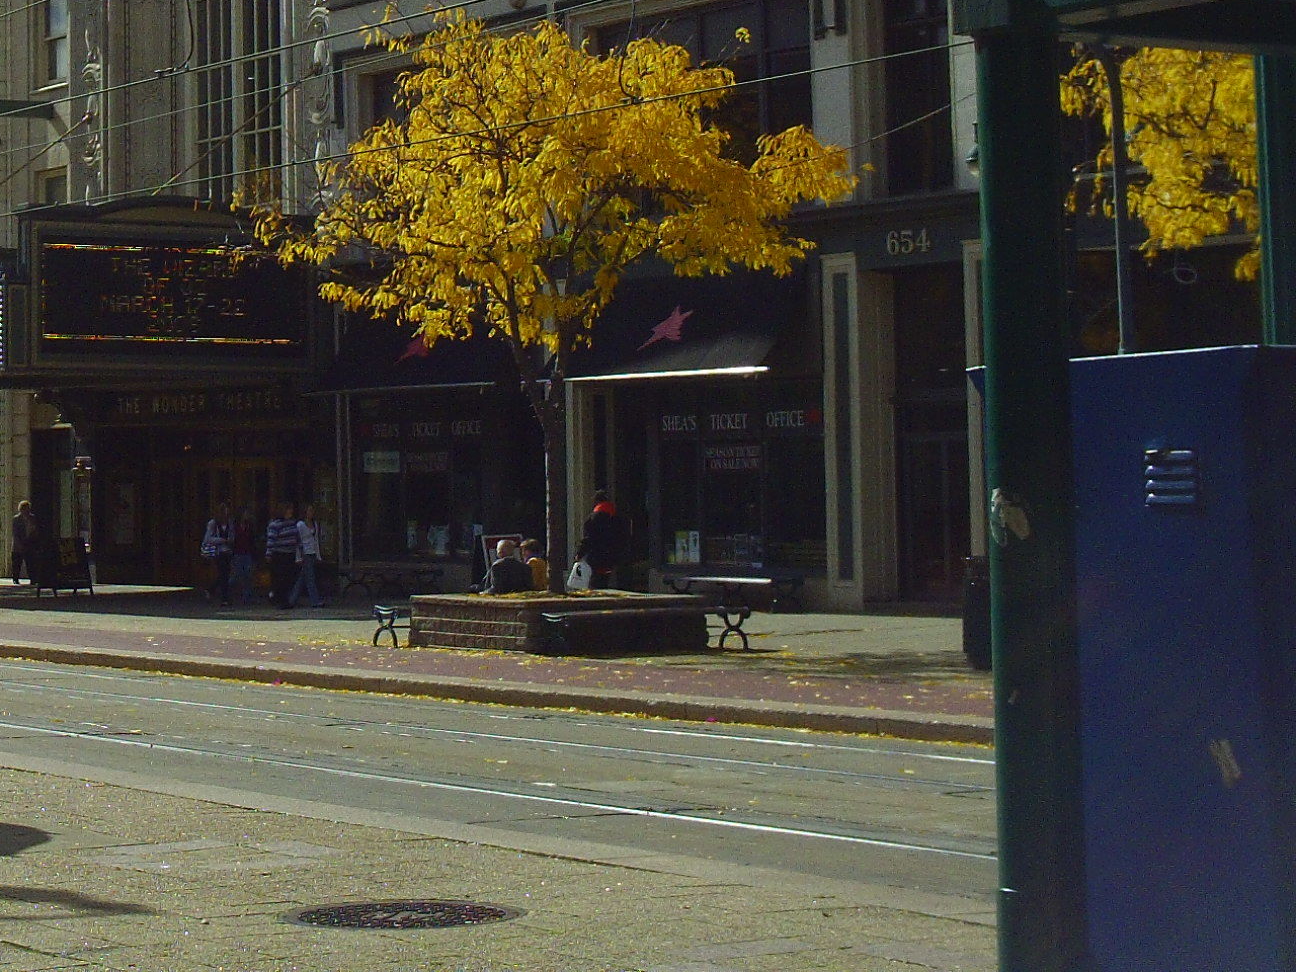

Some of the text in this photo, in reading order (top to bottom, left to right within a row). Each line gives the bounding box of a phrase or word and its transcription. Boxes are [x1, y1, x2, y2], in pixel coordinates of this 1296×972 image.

[887, 228, 931, 255] 654
[100, 295, 174, 314] MARCH
[710, 412, 748, 430] TICKET
[766, 410, 804, 427] OFFICE
